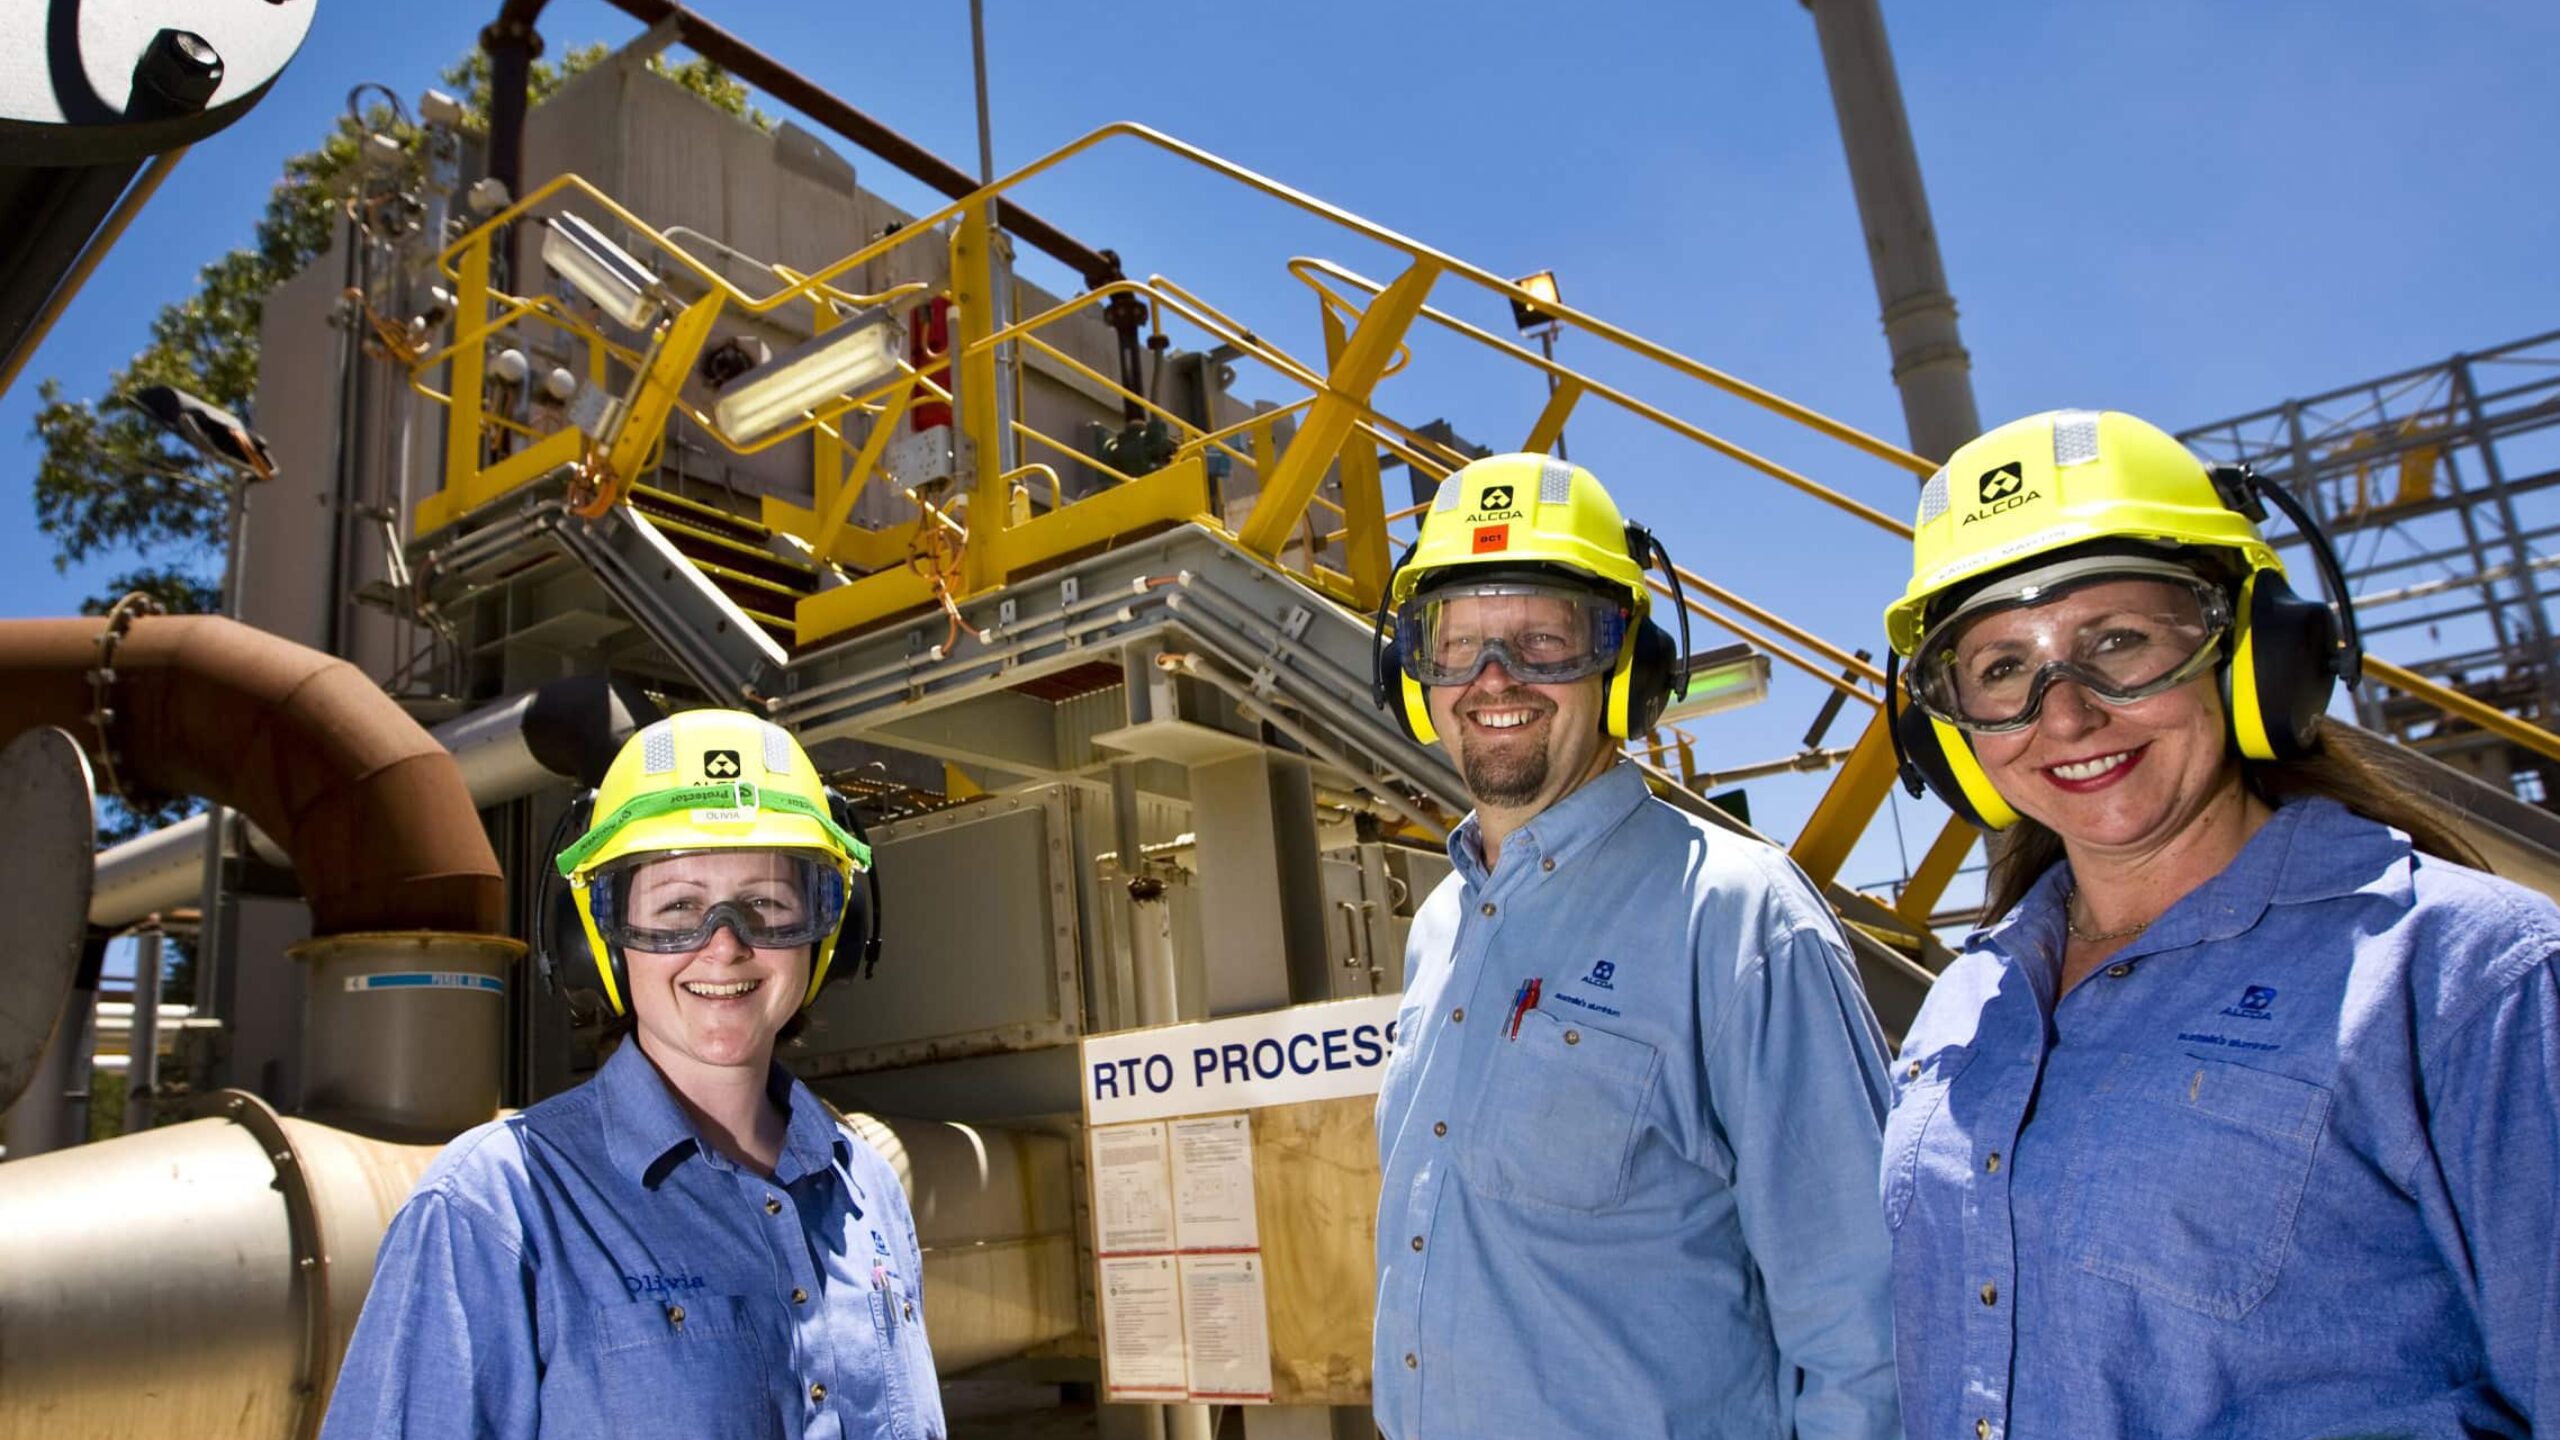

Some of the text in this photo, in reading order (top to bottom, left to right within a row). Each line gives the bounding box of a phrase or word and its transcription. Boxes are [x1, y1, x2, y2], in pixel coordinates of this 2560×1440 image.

[1465, 510, 1523, 523] ALCOA
[1962, 490, 2042, 526] ALCOA
[706, 811, 740, 820] OLIVIA
[1581, 975, 1614, 990] ALCOA
[1094, 1054, 1174, 1100] RTO
[624, 1274, 705, 1294] Olivia
